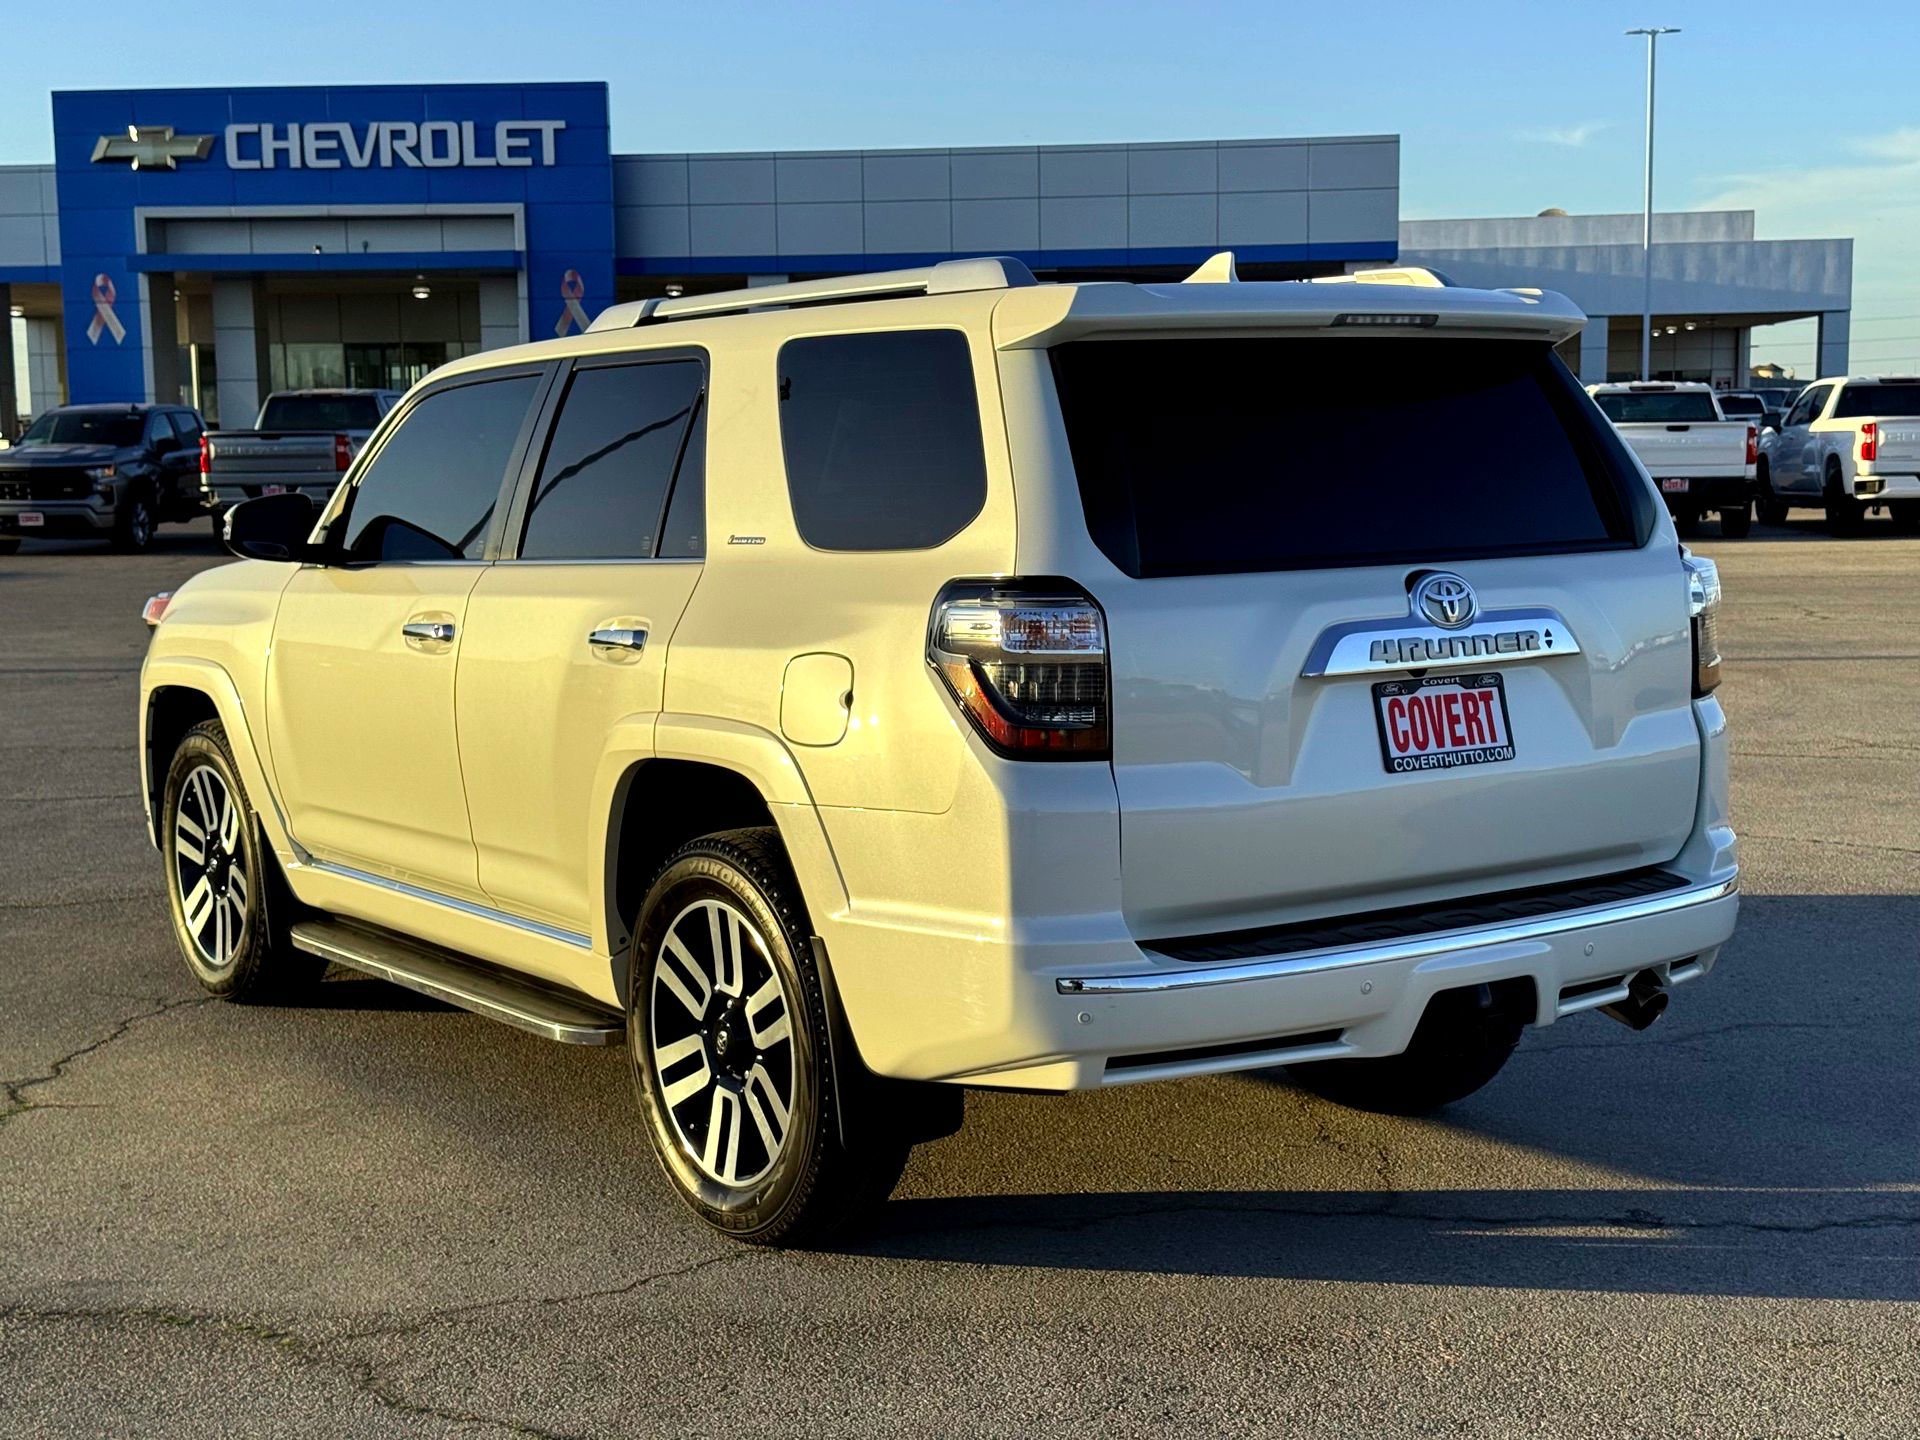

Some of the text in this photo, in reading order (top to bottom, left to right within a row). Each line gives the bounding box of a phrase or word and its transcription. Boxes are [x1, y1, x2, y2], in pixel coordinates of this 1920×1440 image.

[225, 120, 566, 169] CHEVROLET
[1422, 677, 1461, 686] Covert
[1388, 691, 1498, 753] COVERT
[1394, 747, 1514, 772] COVERTHUTTO.COM
